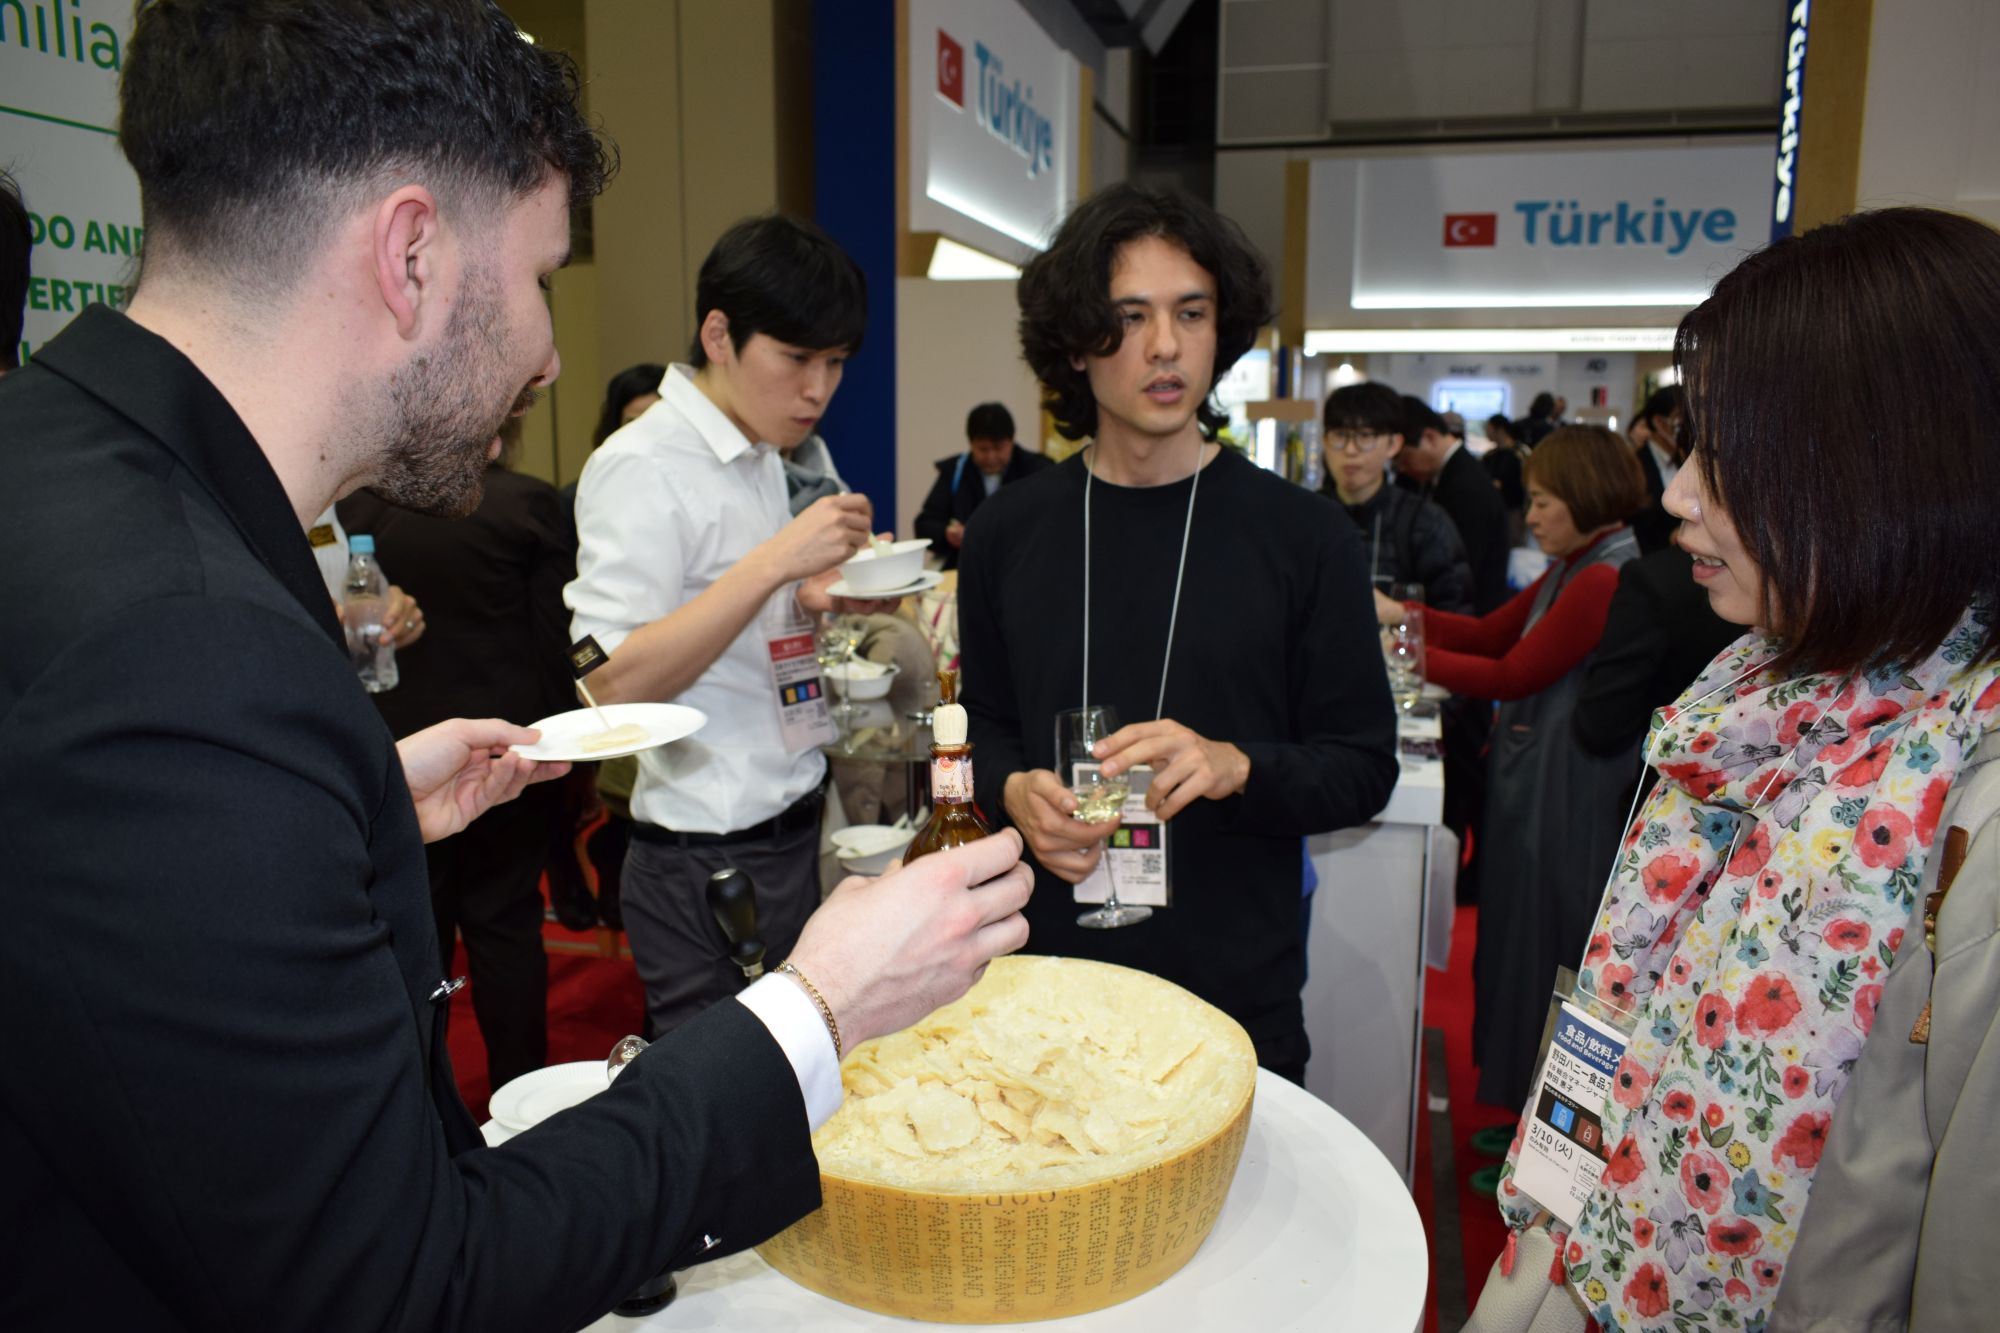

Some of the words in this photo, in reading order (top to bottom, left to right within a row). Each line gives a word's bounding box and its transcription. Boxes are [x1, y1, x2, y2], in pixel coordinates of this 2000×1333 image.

[975, 40, 1052, 176] Türkiye
[1514, 198, 1736, 255] Türkiye
[1557, 1031, 1571, 1046] Food
[1571, 1041, 1583, 1053] and
[1583, 1048, 1614, 1071] Beverage
[1531, 1123, 1553, 1145] 3/10
[926, 1201, 954, 1312] PARMIGIANO
[959, 1203, 984, 1298] REGGIANO
[1085, 1187, 1111, 1287] REGGIANO
